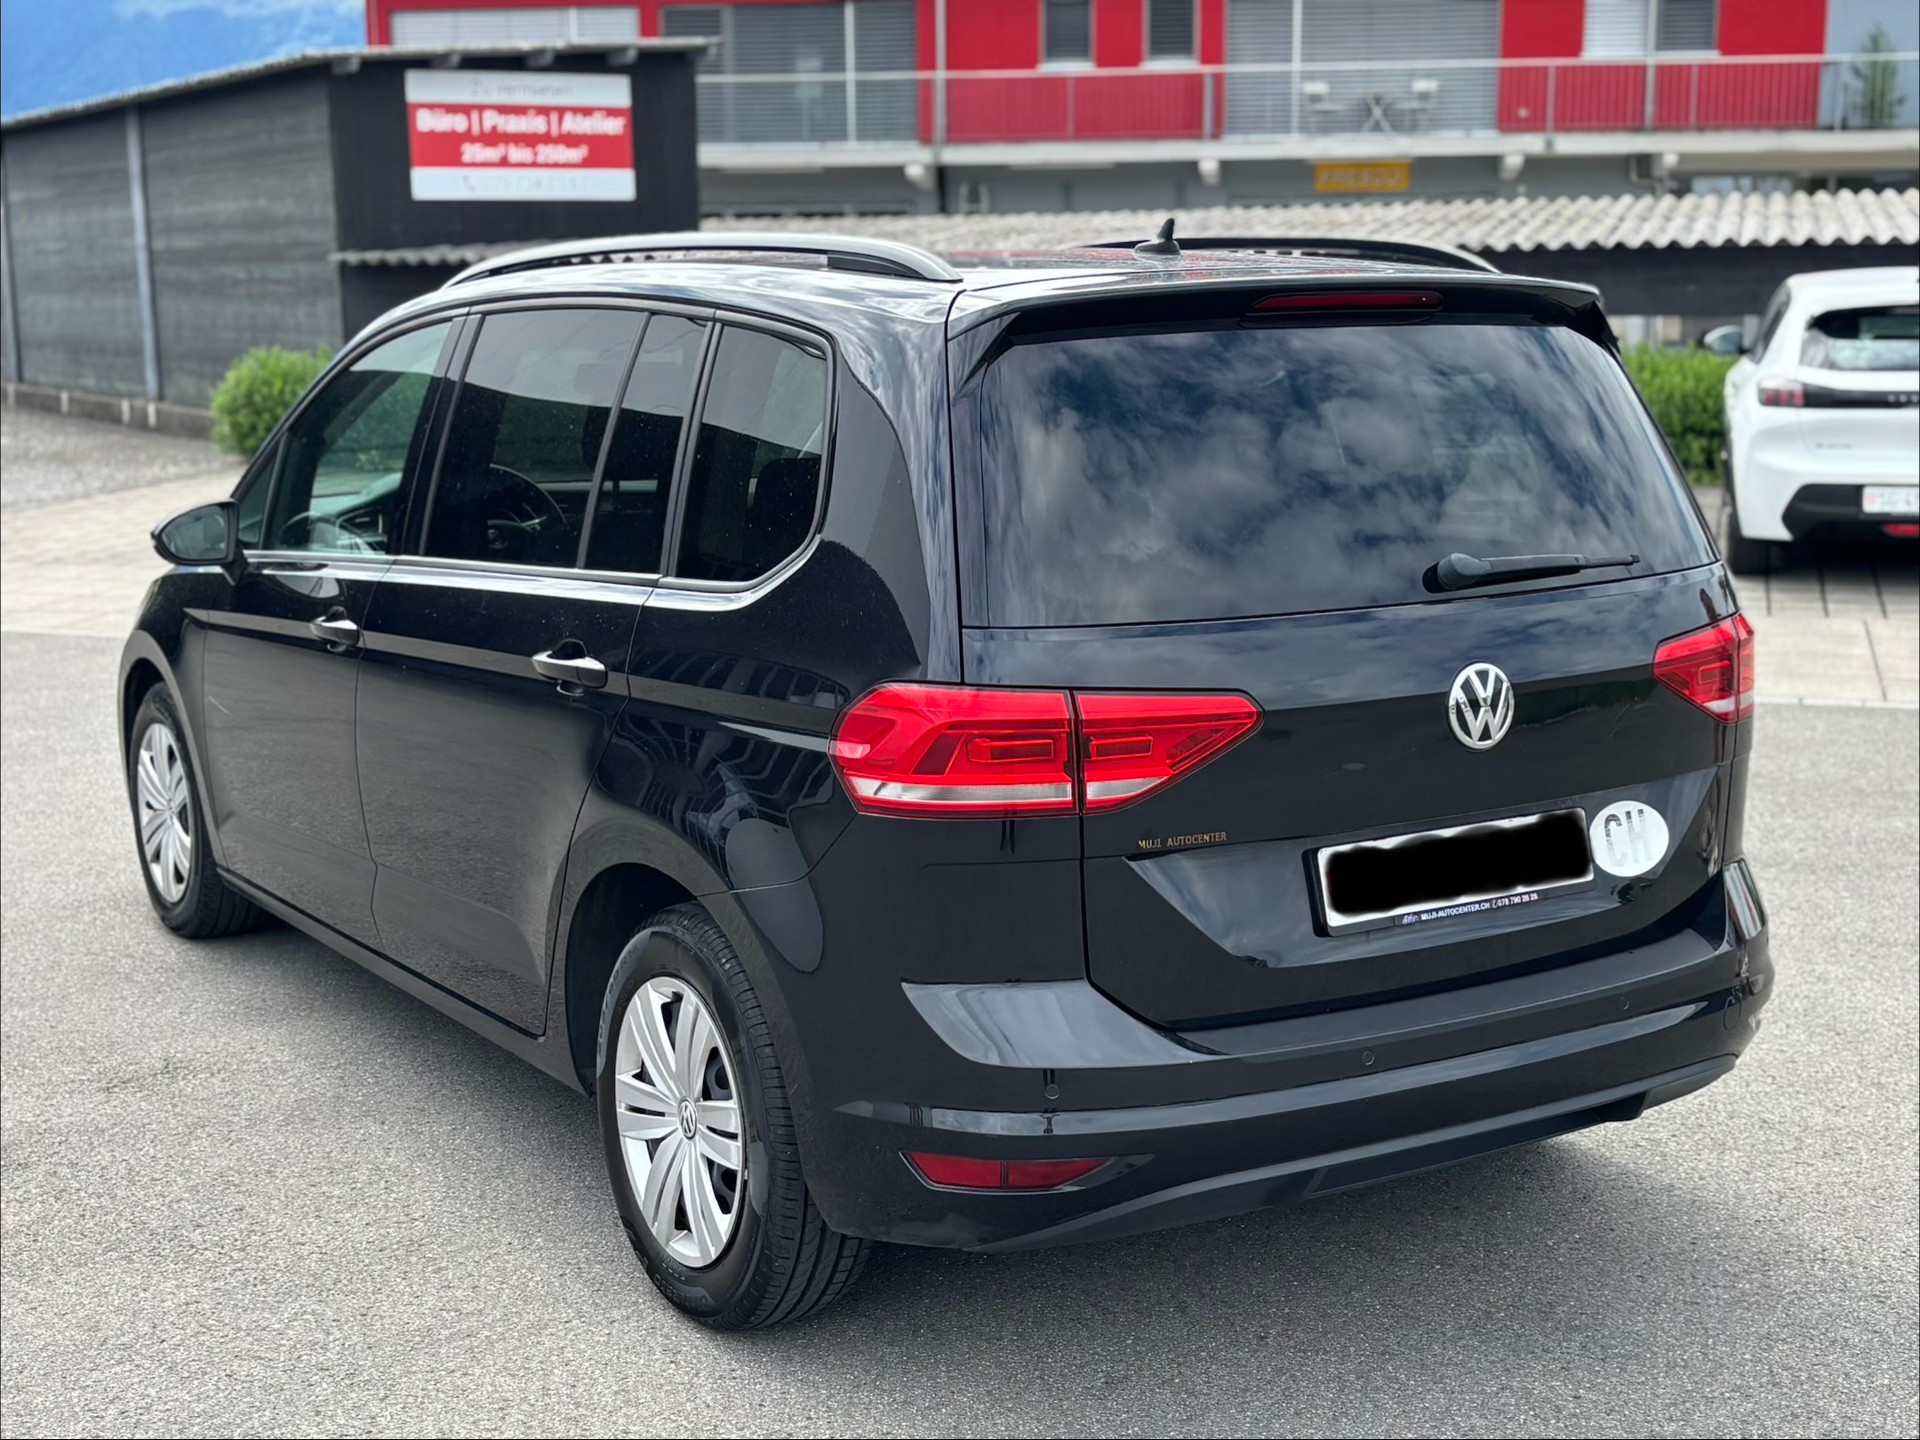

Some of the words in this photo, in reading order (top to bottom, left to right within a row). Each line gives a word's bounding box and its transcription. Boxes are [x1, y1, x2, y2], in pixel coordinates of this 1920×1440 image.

[415, 108, 469, 133] Büro
[481, 109, 548, 134] Praxis
[561, 110, 627, 136] Atelier
[507, 143, 534, 163] bis
[1138, 838, 1162, 849] MUJI
[1167, 831, 1227, 847] AUTOCENTER
[1604, 808, 1655, 867] CH
